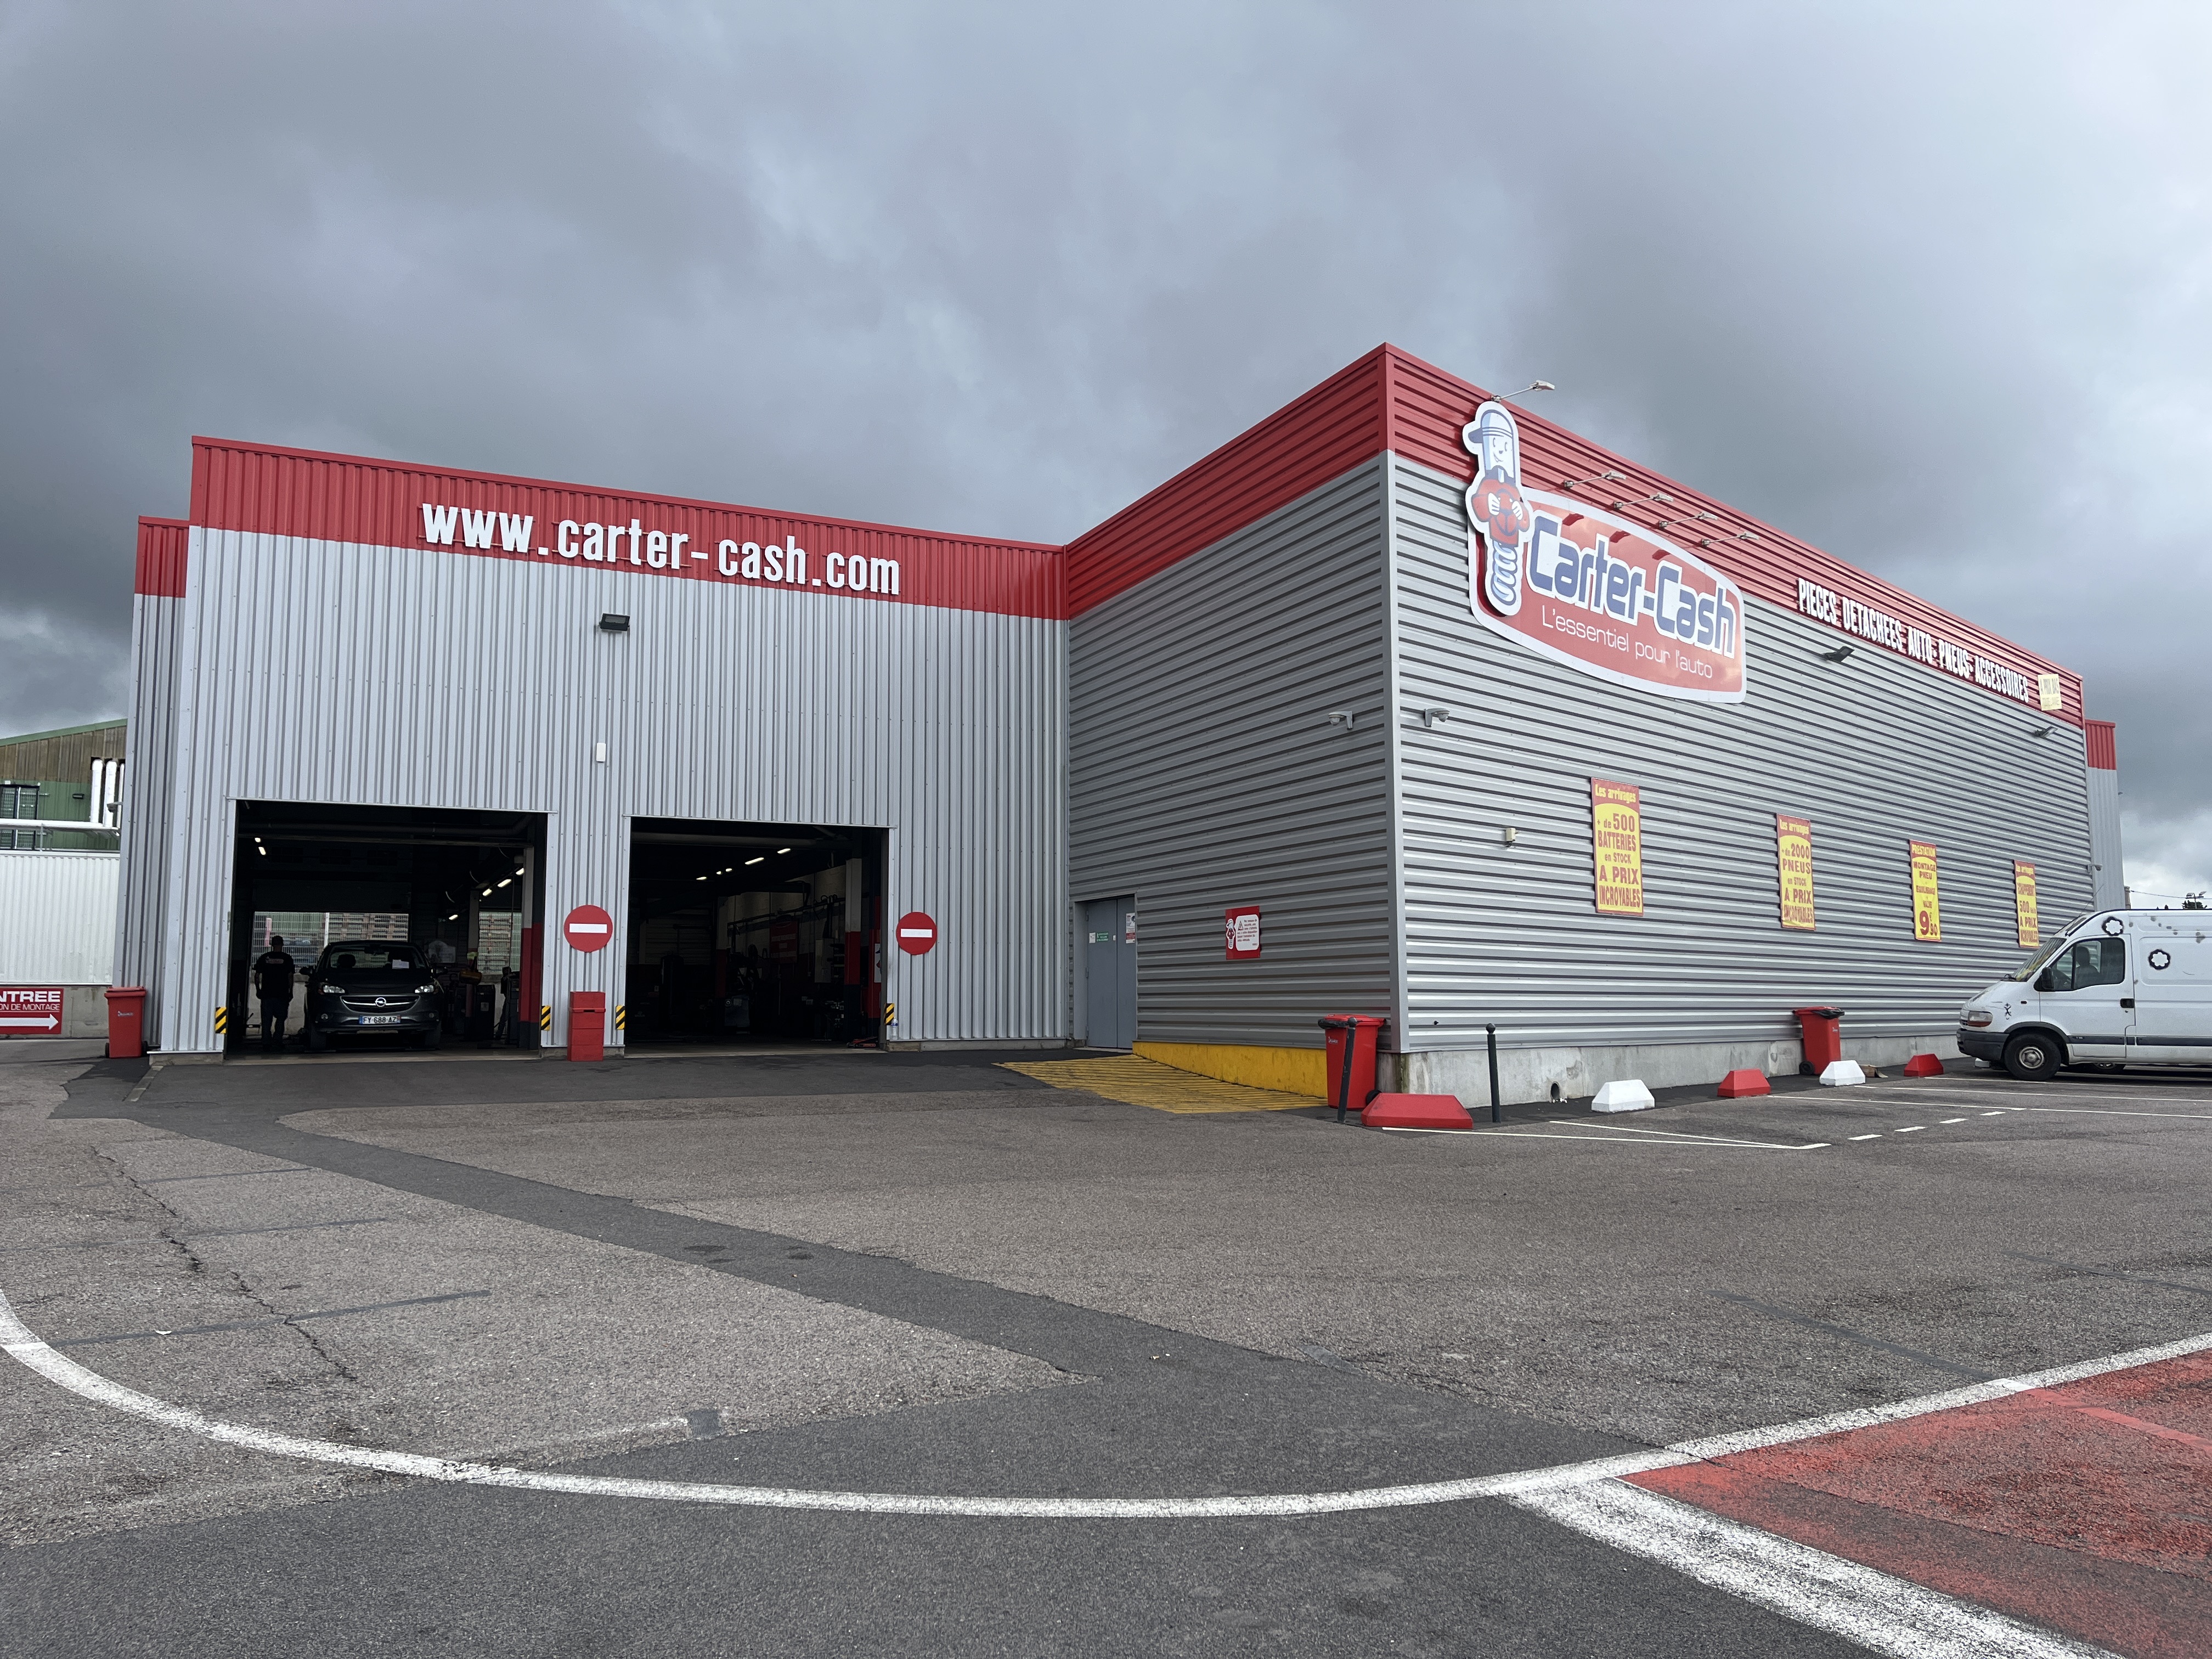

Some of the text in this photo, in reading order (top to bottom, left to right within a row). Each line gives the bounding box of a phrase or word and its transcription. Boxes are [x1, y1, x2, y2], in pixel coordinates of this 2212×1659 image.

[1530, 514, 1735, 656] Carter-Cash
[1542, 605, 1713, 679] L'essentiel pour l'auto
[1798, 577, 2029, 703] PIECES DETACHEES AUTO PNEUS ACCESSOIRES
[1595, 784, 1636, 804] Les arrivages
[1604, 819, 1611, 828] de
[1613, 812, 1635, 832] 500
[1598, 830, 1636, 851] BATTERIES
[1605, 853, 1632, 864] en STOCK
[1791, 843, 1810, 859] 2000
[1599, 865, 1639, 885] A PRIX
[1782, 858, 1810, 874] PNEUS
[1913, 861, 1936, 872] MONTAGE
[1599, 885, 1640, 908] INCROYABLES
[1784, 887, 1812, 905] A PRIX
